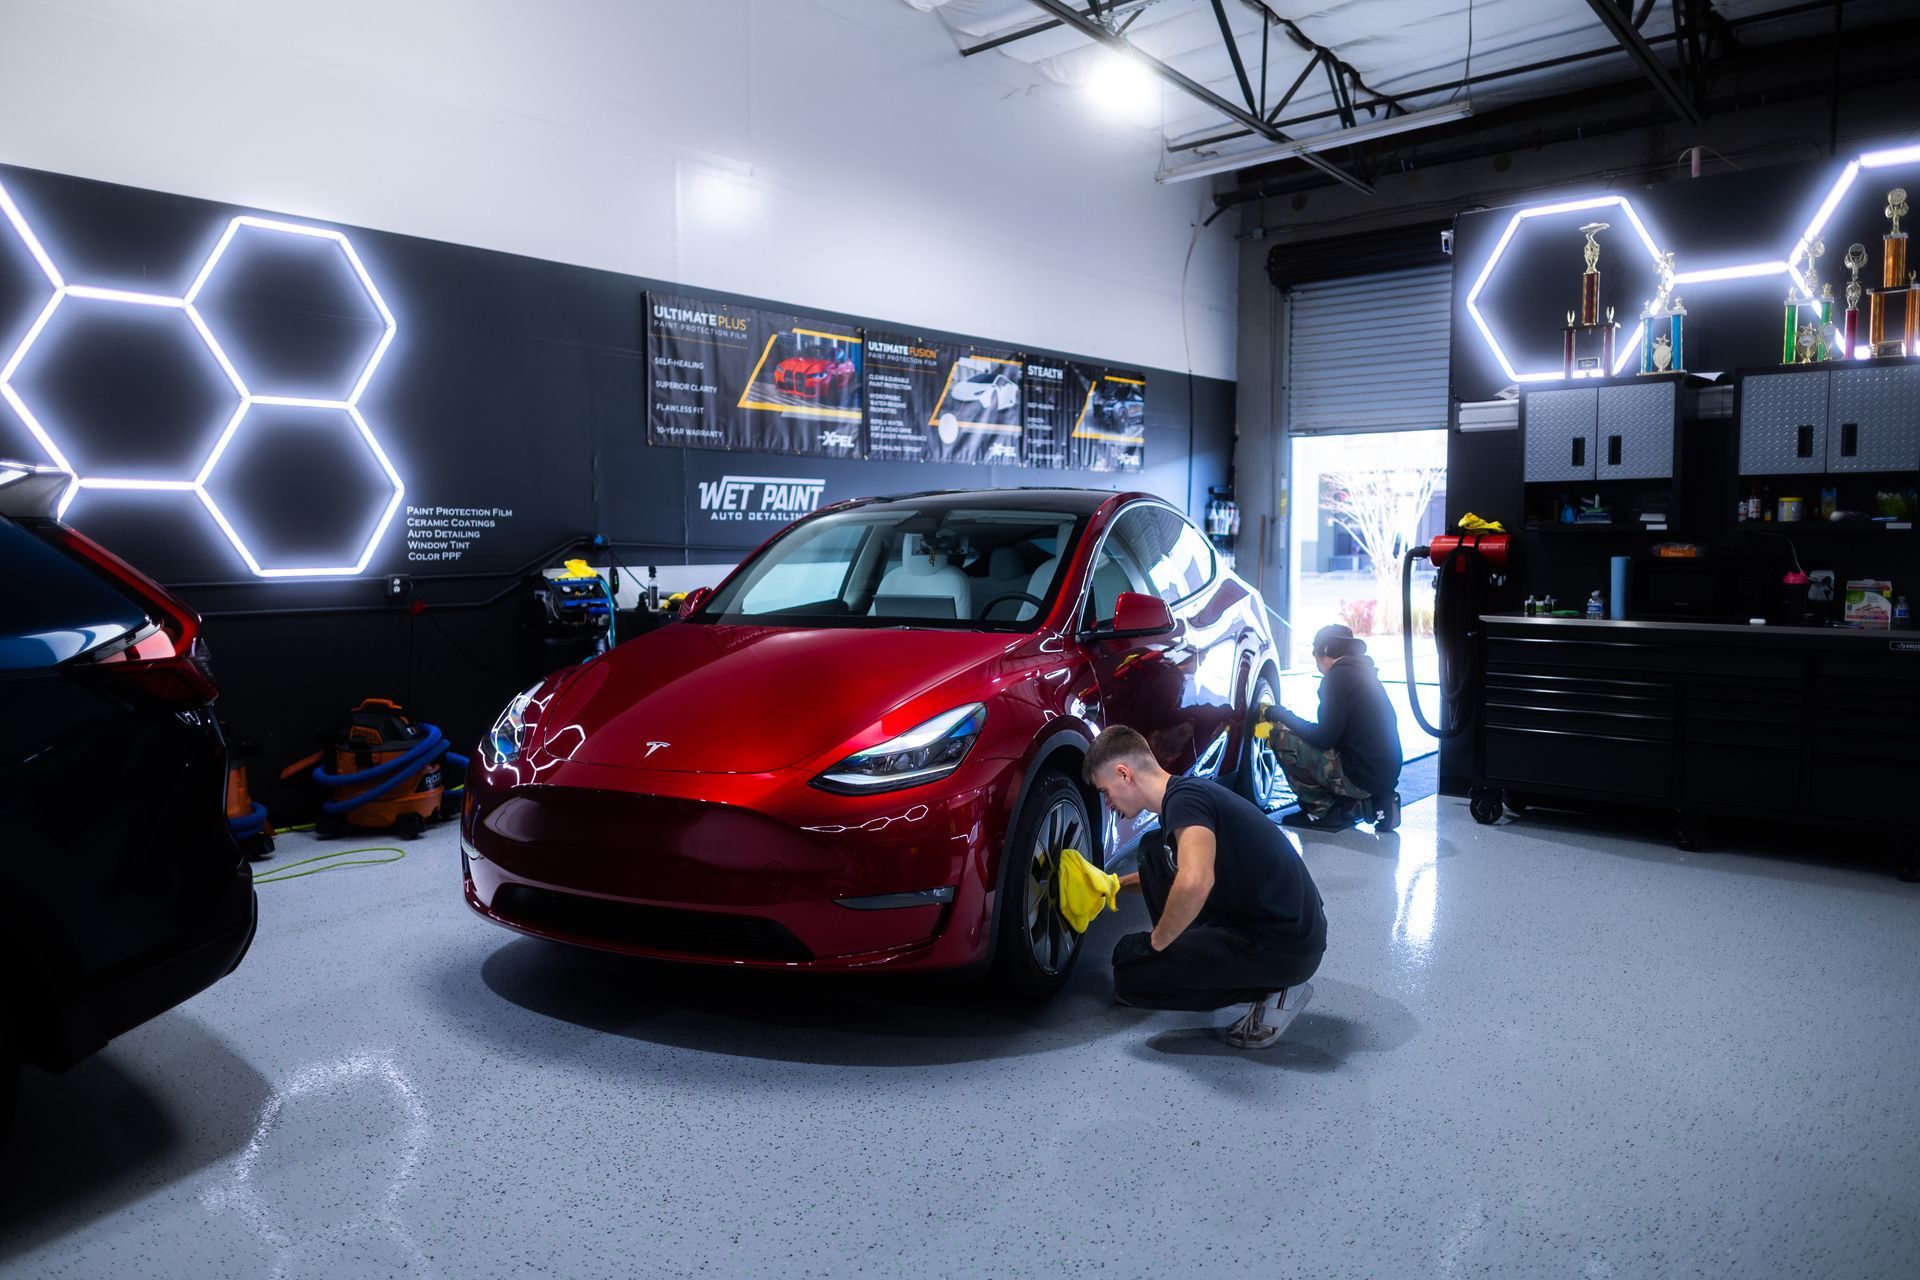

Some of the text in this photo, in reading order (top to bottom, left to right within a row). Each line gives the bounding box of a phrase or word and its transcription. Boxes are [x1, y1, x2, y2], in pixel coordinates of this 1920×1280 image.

[654, 320, 748, 340] PAINT PROTECTION FILM
[654, 357, 704, 370] SELF-HEALING
[1027, 365, 1063, 379] STEALTH
[656, 380, 718, 394] SUPERIOR CLARITY
[656, 403, 705, 415] FLAWLESS FIT
[656, 427, 723, 438] 10-YEAR WARRANTY
[820, 431, 855, 448] XPEL
[698, 476, 824, 511] WET PAINT
[406, 506, 513, 517] PAINT PROTECTION FILM
[711, 512, 811, 521] AUTO DETAILIN
[406, 518, 496, 528] CERAMIC COATINGS
[407, 529, 480, 538] AUTO DETAILING
[407, 541, 470, 549] WINDOW TINT
[408, 552, 462, 561] COLOR PPF
